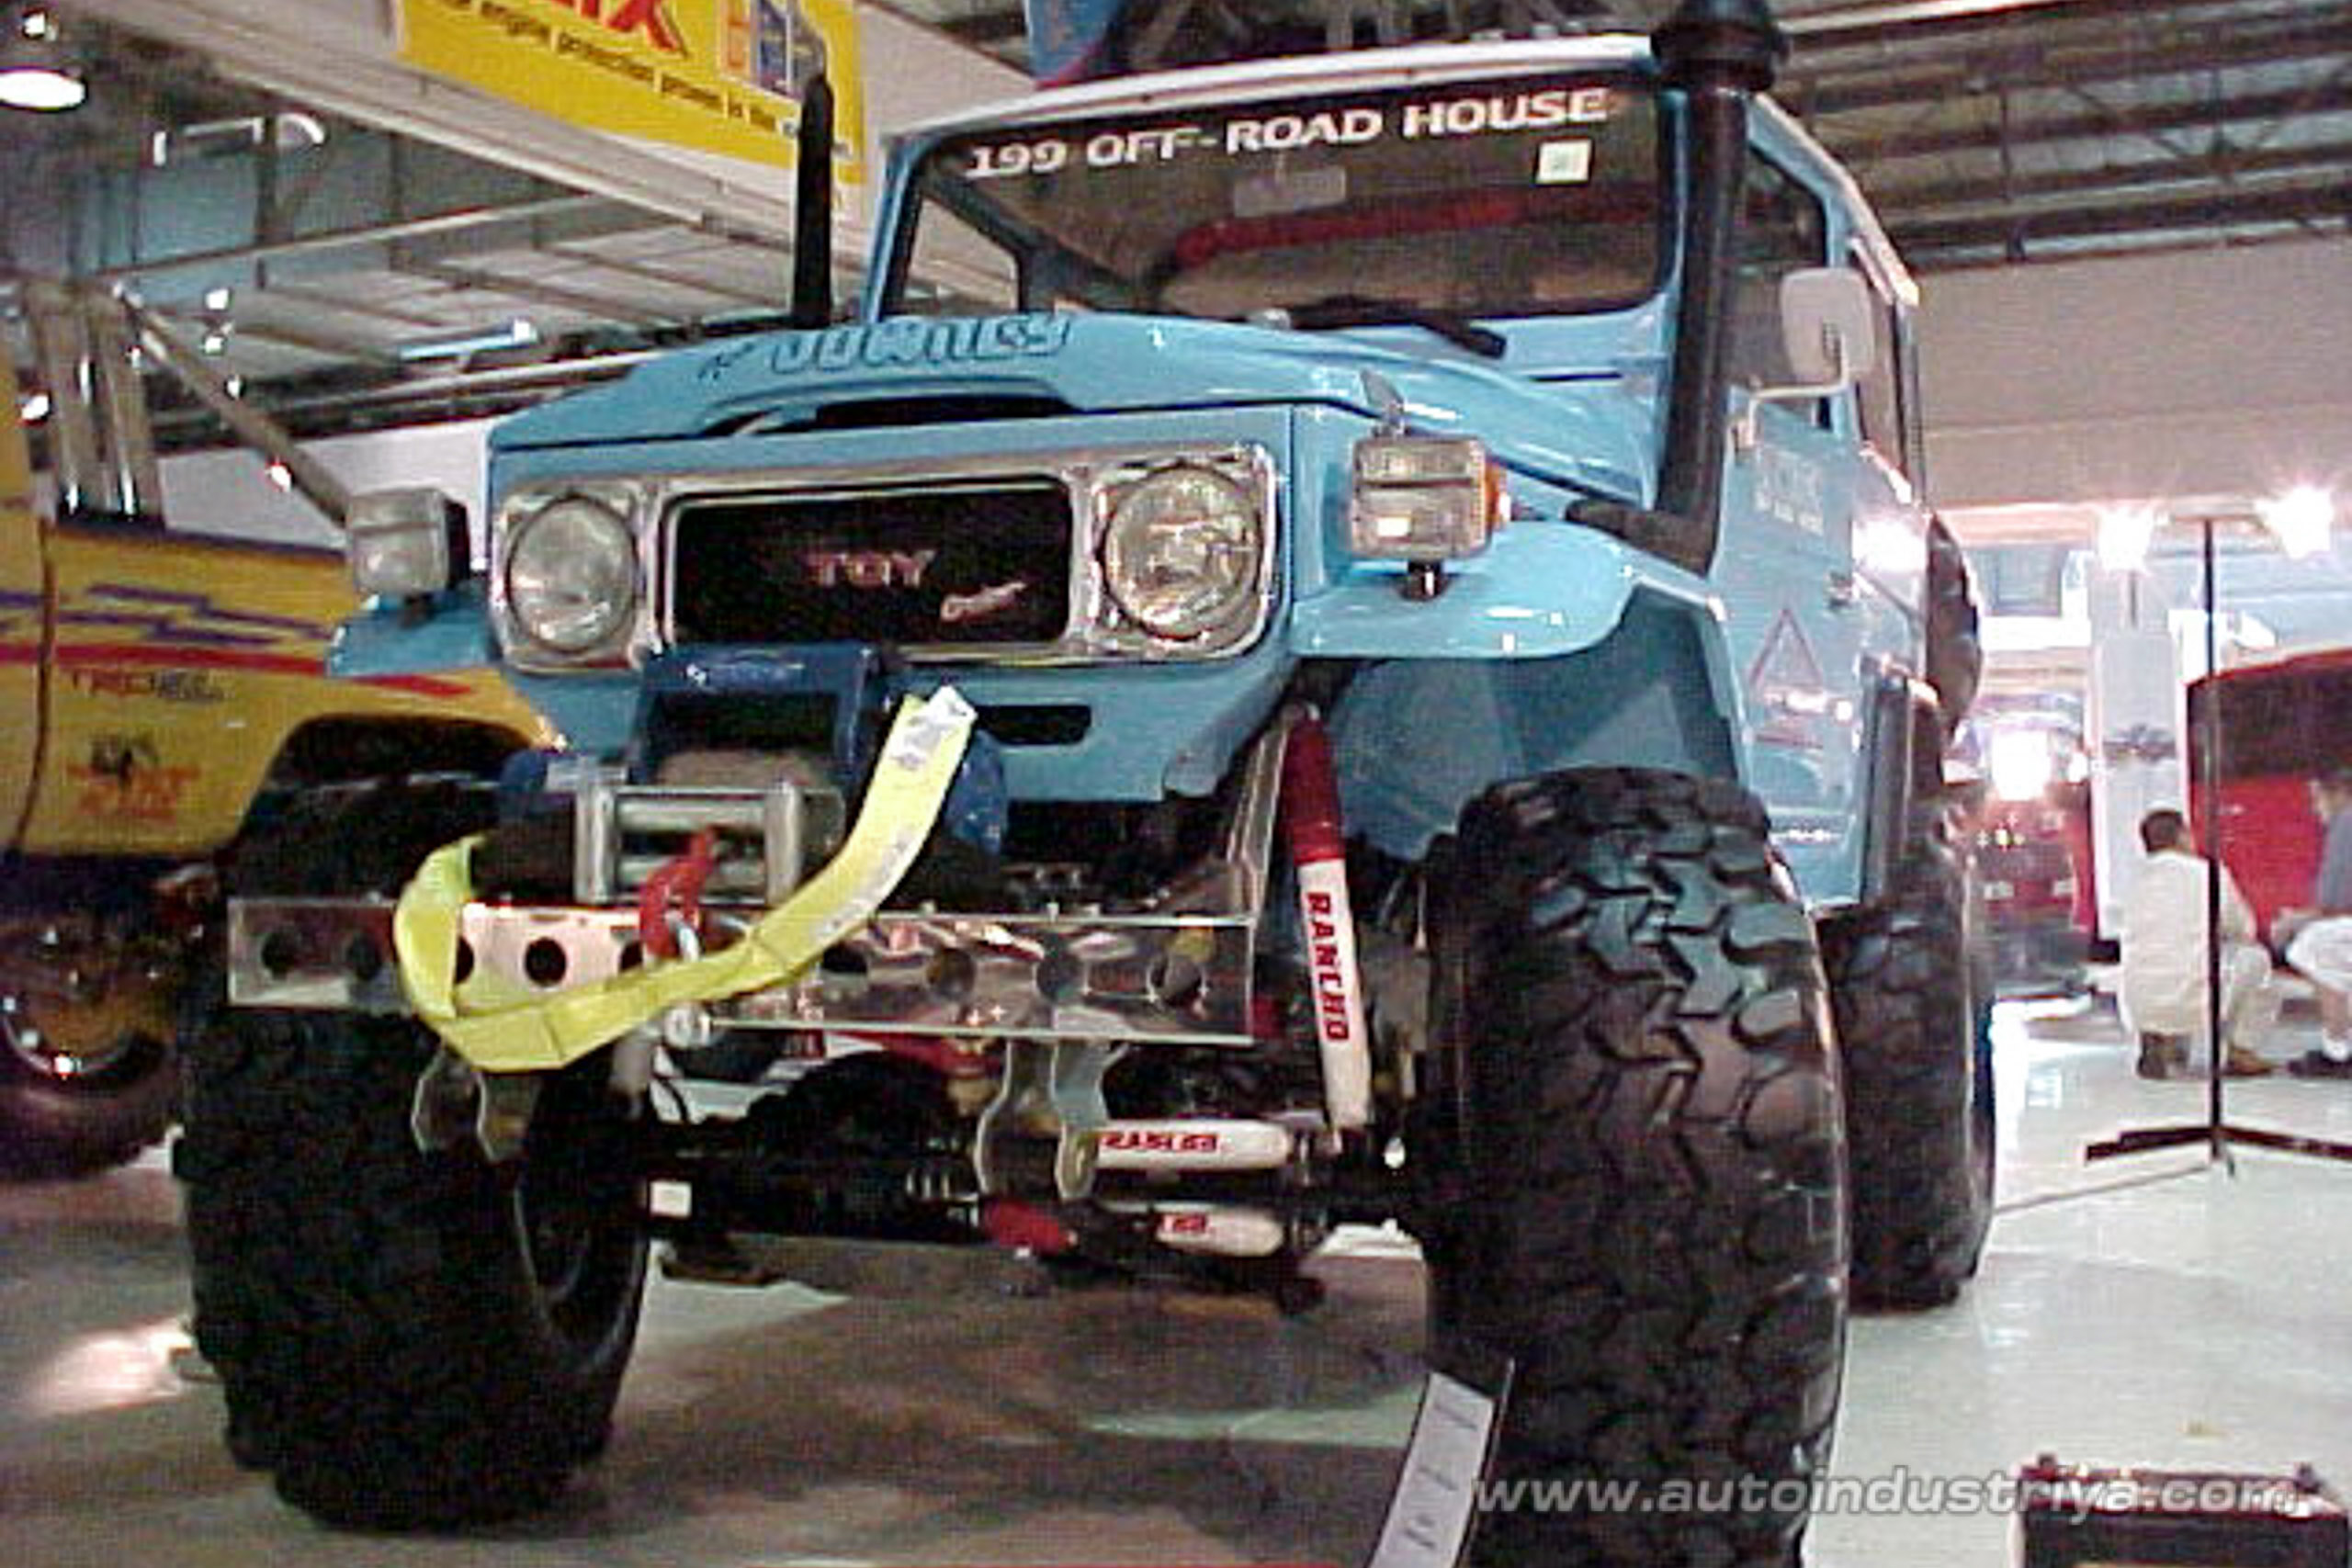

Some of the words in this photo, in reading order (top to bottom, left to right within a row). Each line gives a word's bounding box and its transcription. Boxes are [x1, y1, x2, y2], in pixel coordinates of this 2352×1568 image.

[965, 140, 1068, 178] 199
[1402, 87, 1609, 138] HOUSE
[1306, 891, 1351, 1043] RANCHO
